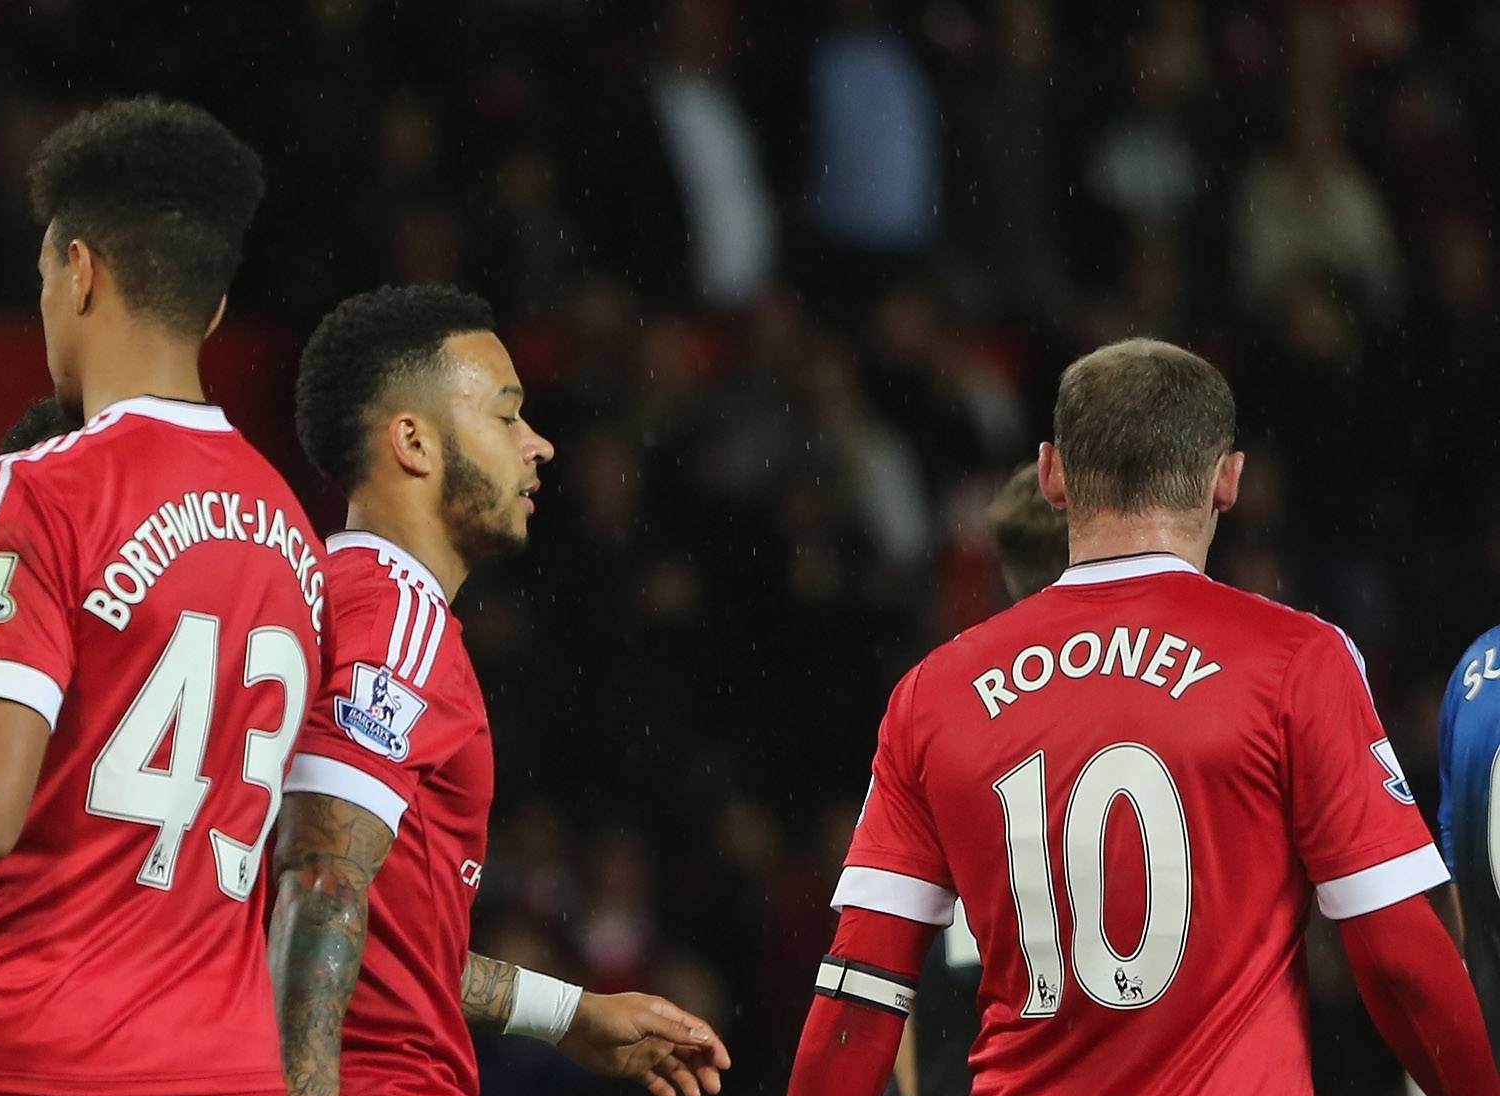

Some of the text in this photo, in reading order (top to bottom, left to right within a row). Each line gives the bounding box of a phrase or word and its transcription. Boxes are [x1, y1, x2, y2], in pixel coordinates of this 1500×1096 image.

[82, 489, 324, 646] BORTHWICK-JACKSO
[971, 627, 1222, 720] ROONEY
[84, 609, 310, 903] 43
[991, 741, 1193, 1019] 10
